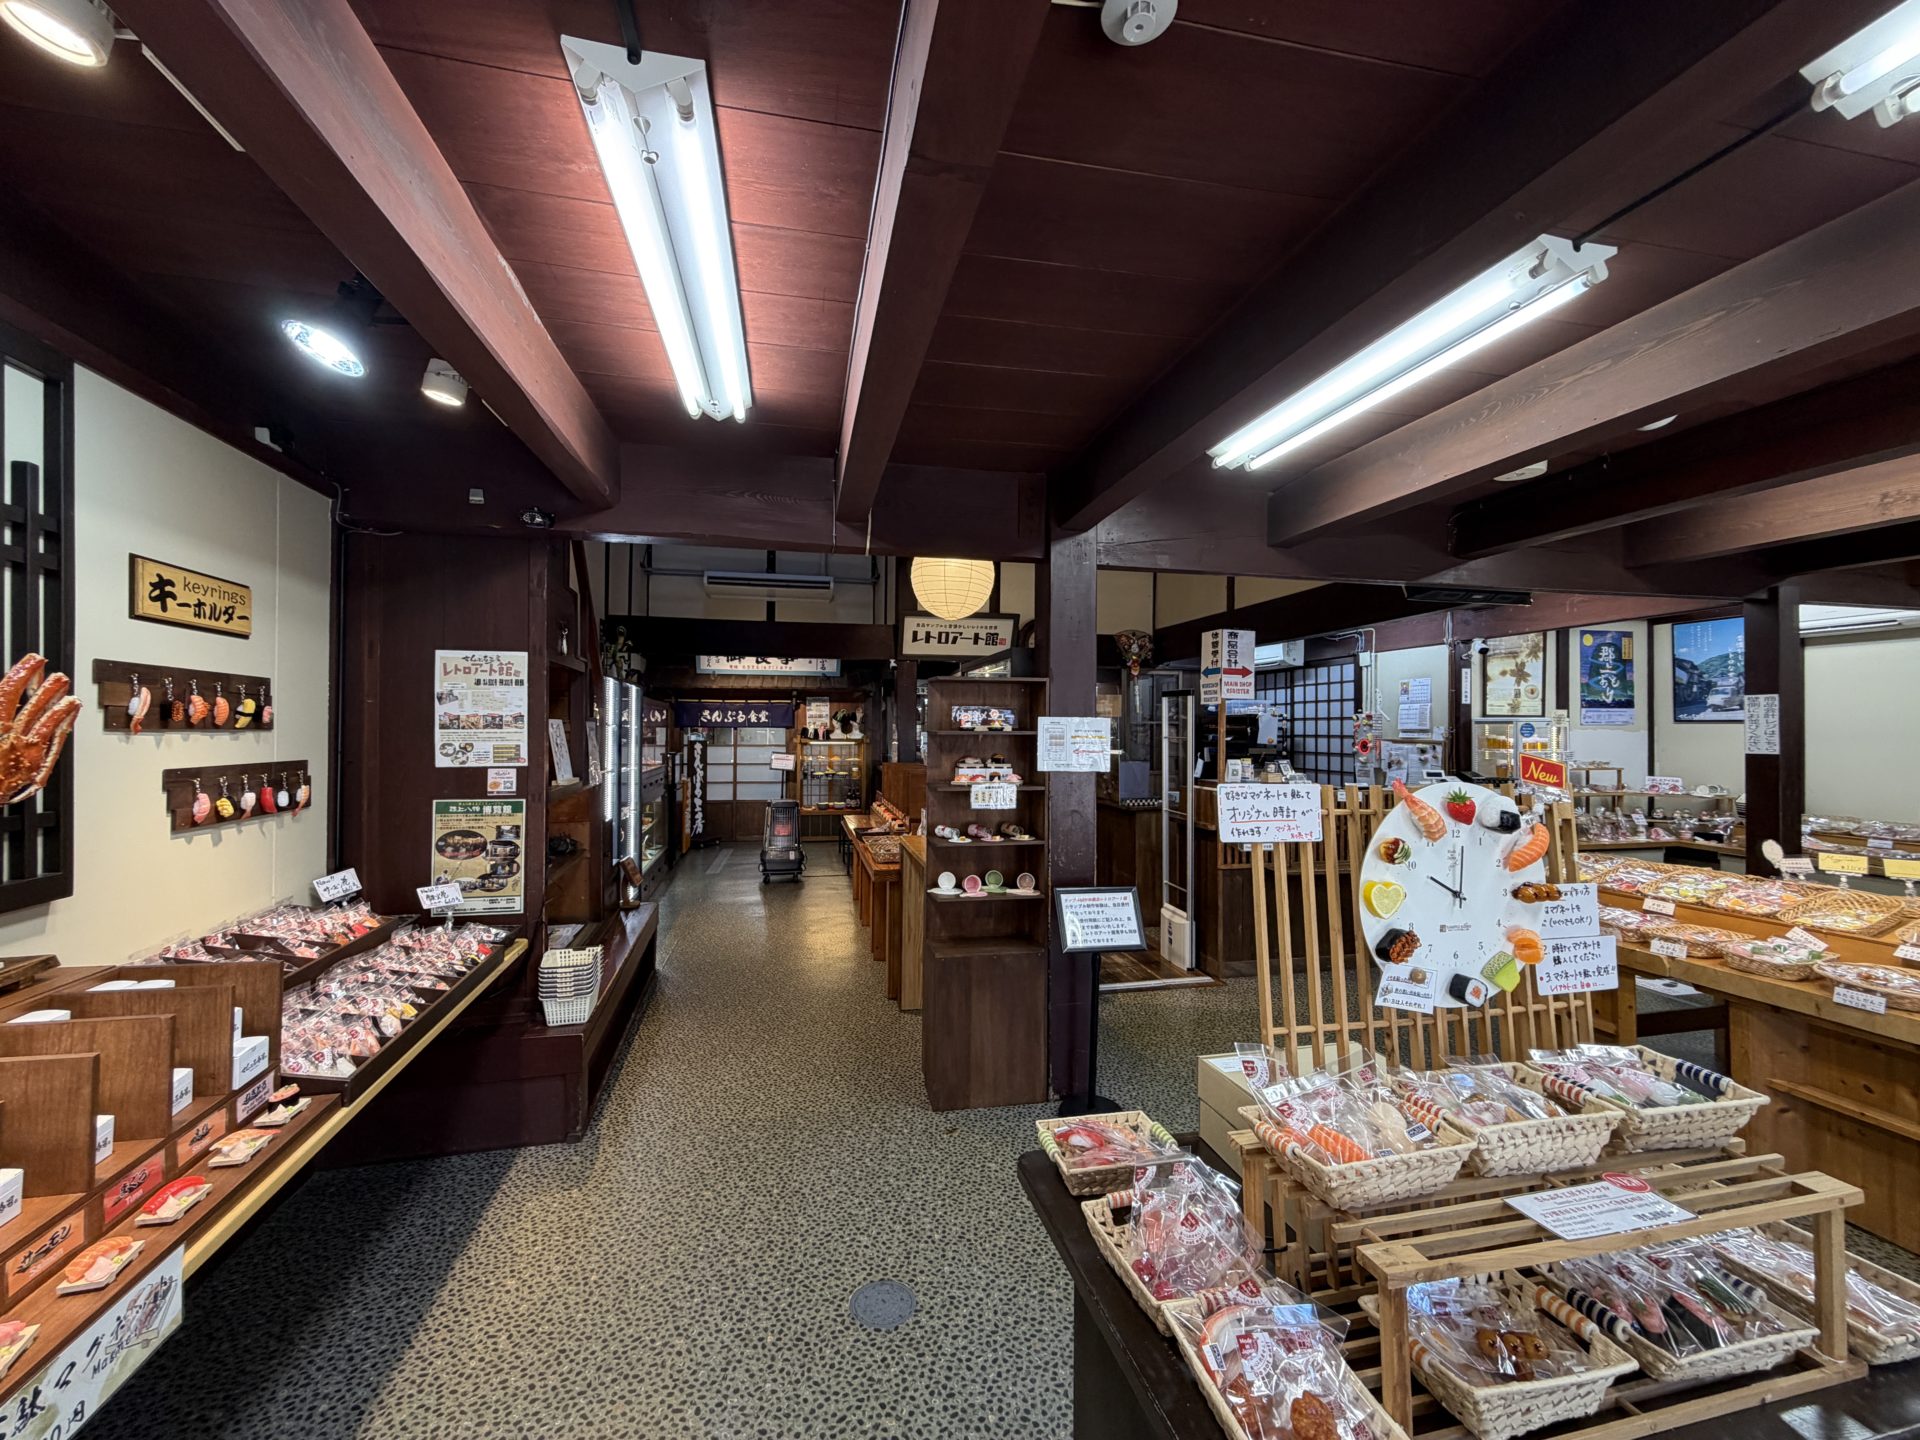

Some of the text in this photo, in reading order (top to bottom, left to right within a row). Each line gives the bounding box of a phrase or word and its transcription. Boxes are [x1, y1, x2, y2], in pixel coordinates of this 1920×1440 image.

[149, 573, 249, 624] キーホルダー
[183, 576, 246, 606] keyrings
[912, 630, 999, 646] レトロアート館
[1211, 632, 1219, 668] 体験受付
[1227, 631, 1239, 667] 商品会計
[443, 661, 514, 677] レトロアート館
[1598, 646, 1620, 704] 郡上おどり
[700, 709, 769, 723] さんぷる食堂
[1525, 761, 1559, 783] New
[1225, 788, 1312, 800] 好きなマグネットを貼って
[1451, 830, 1461, 838] 12
[1407, 861, 1417, 870] 10
[1496, 859, 1501, 868] 2
[1502, 889, 1508, 897] 3
[1496, 919, 1501, 928] 4
[1428, 944, 1433, 953] 7
[1478, 942, 1483, 950] 5
[1453, 952, 1459, 960] 6
[1836, 991, 1884, 1007] みたらしだんご
[119, 1169, 149, 1196] まぐろ
[1607, 1176, 1643, 1186] NEW
[18, 1224, 72, 1271] サーモン
